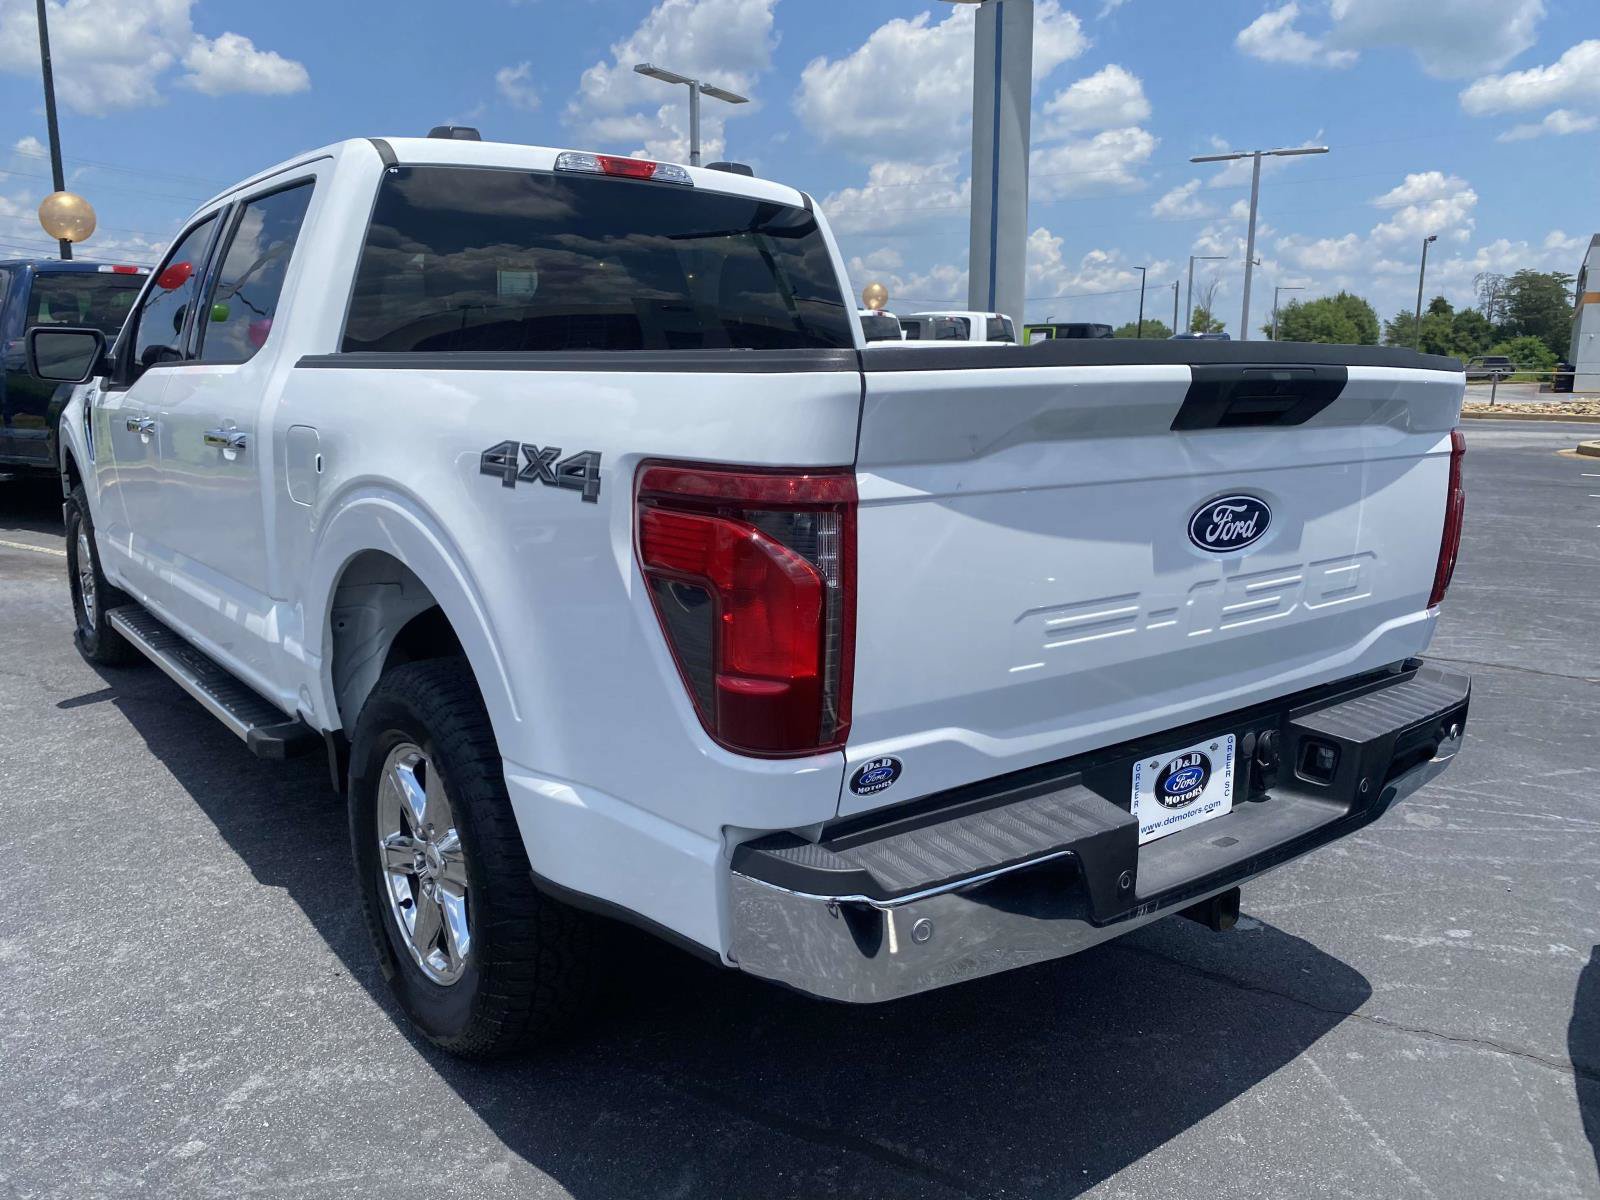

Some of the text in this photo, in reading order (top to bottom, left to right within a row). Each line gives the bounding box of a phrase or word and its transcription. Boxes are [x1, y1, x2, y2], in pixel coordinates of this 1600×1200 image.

[1205, 504, 1259, 542] Ford
[863, 758, 892, 774] D&D
[1169, 753, 1202, 774] D&D
[1224, 736, 1234, 797] GREER SC
[858, 779, 893, 794] MOTORS
[865, 770, 887, 783] Ford
[1133, 763, 1141, 808] GREER
[1172, 771, 1198, 790] Ford
[1164, 784, 1203, 806] MOTORS
[1140, 800, 1221, 834] www.ddmotors.com
